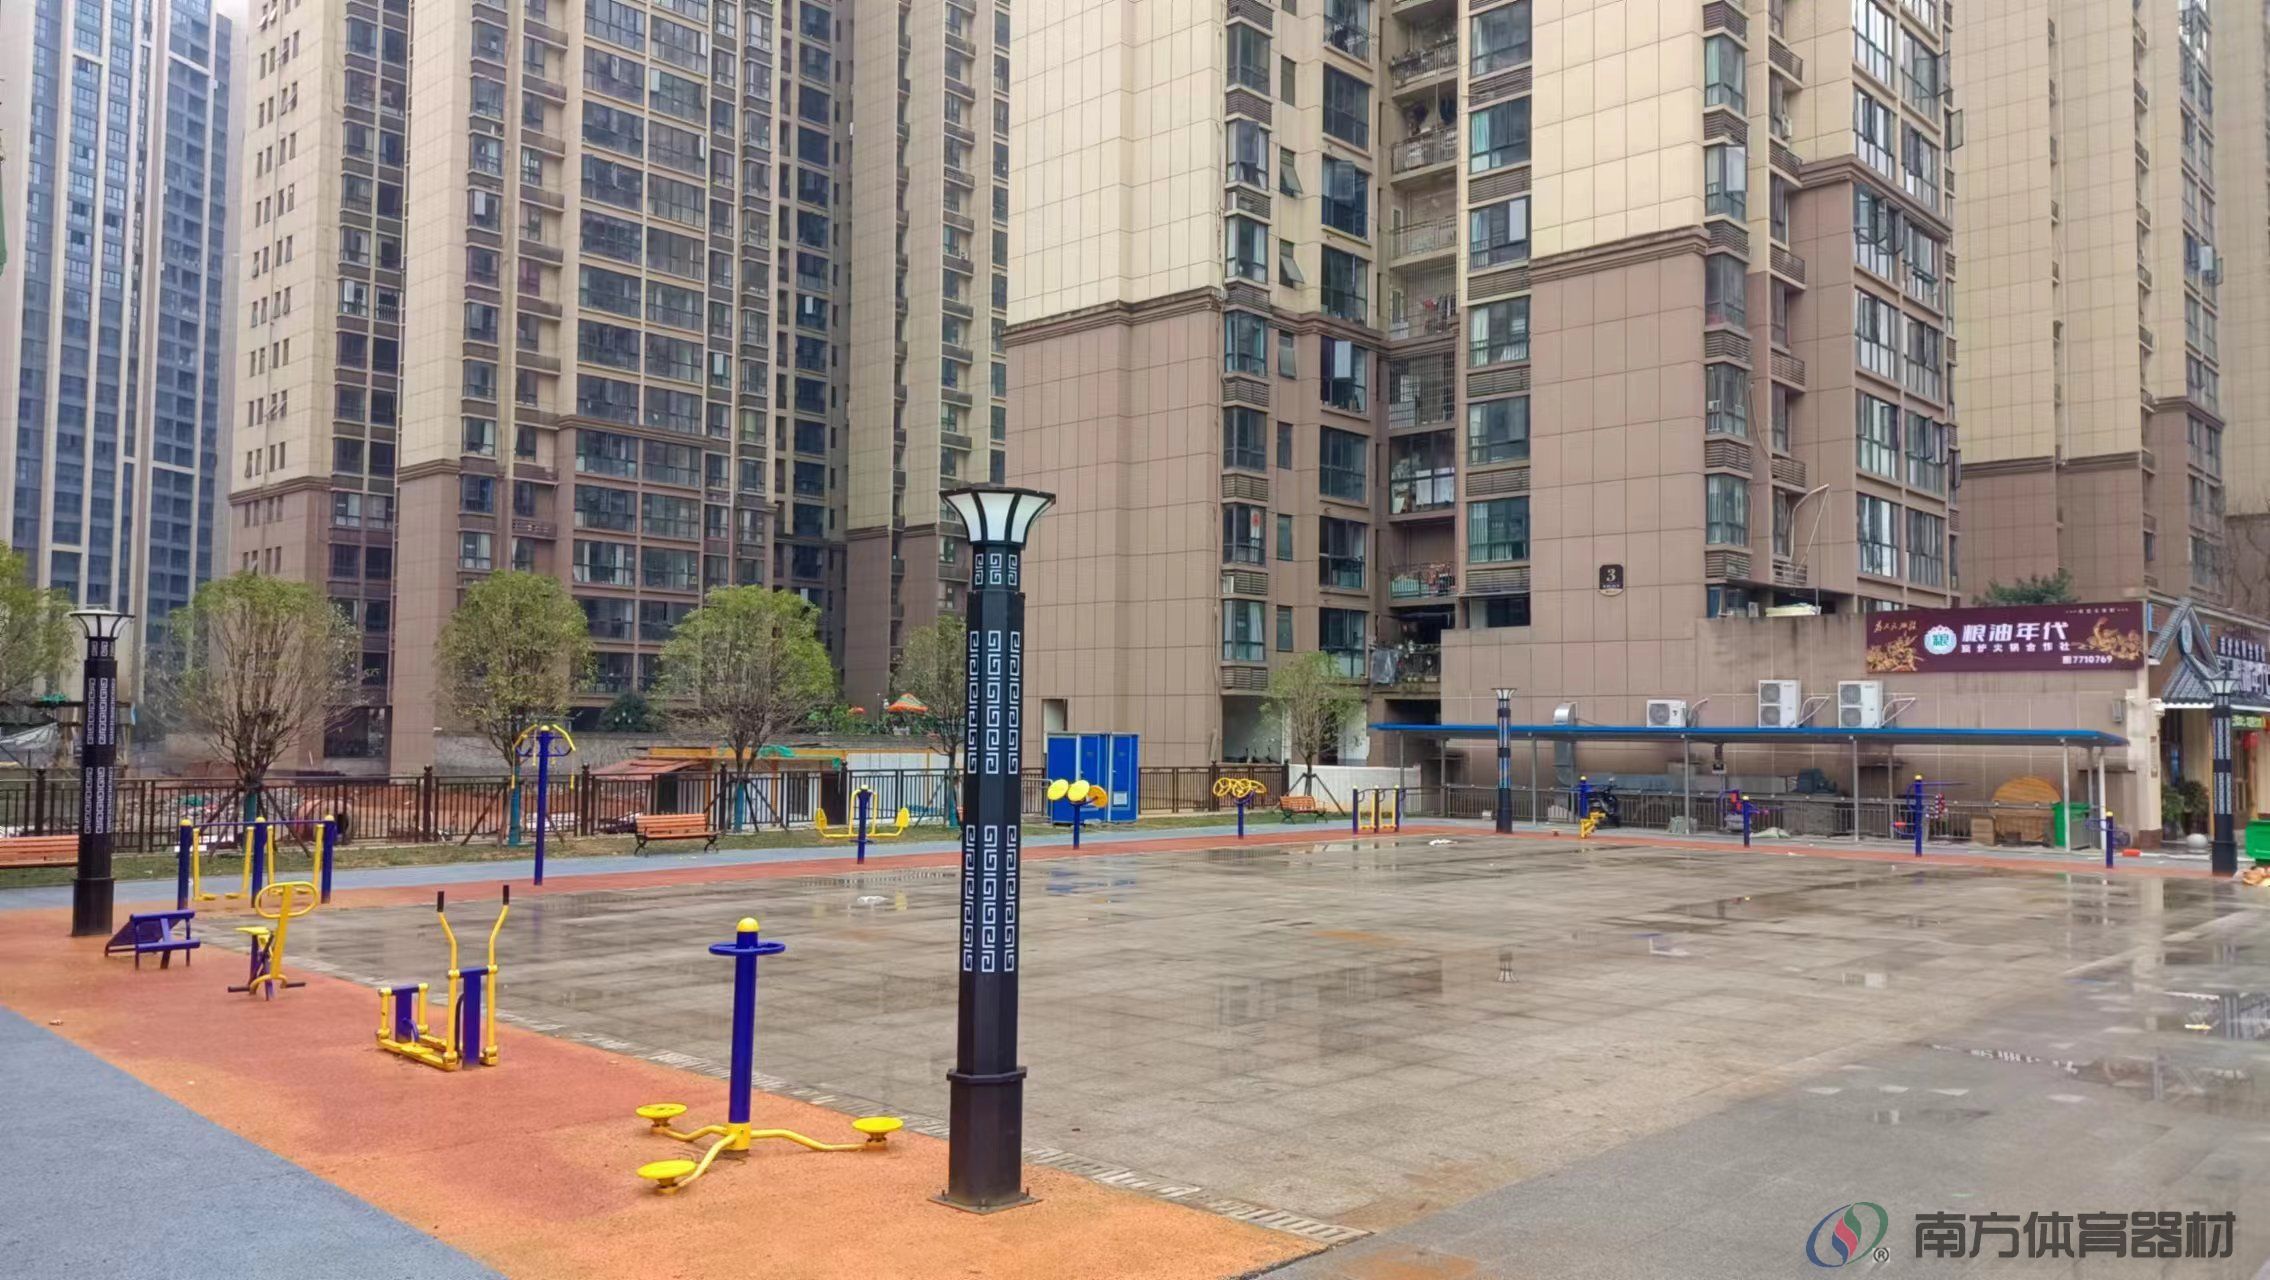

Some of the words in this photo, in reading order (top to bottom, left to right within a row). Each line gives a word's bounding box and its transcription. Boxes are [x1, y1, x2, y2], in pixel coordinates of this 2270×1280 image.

[1606, 568, 1617, 582] 3
[1961, 621, 2070, 642] 粮油年代
[2072, 654, 2113, 664] 7710769
